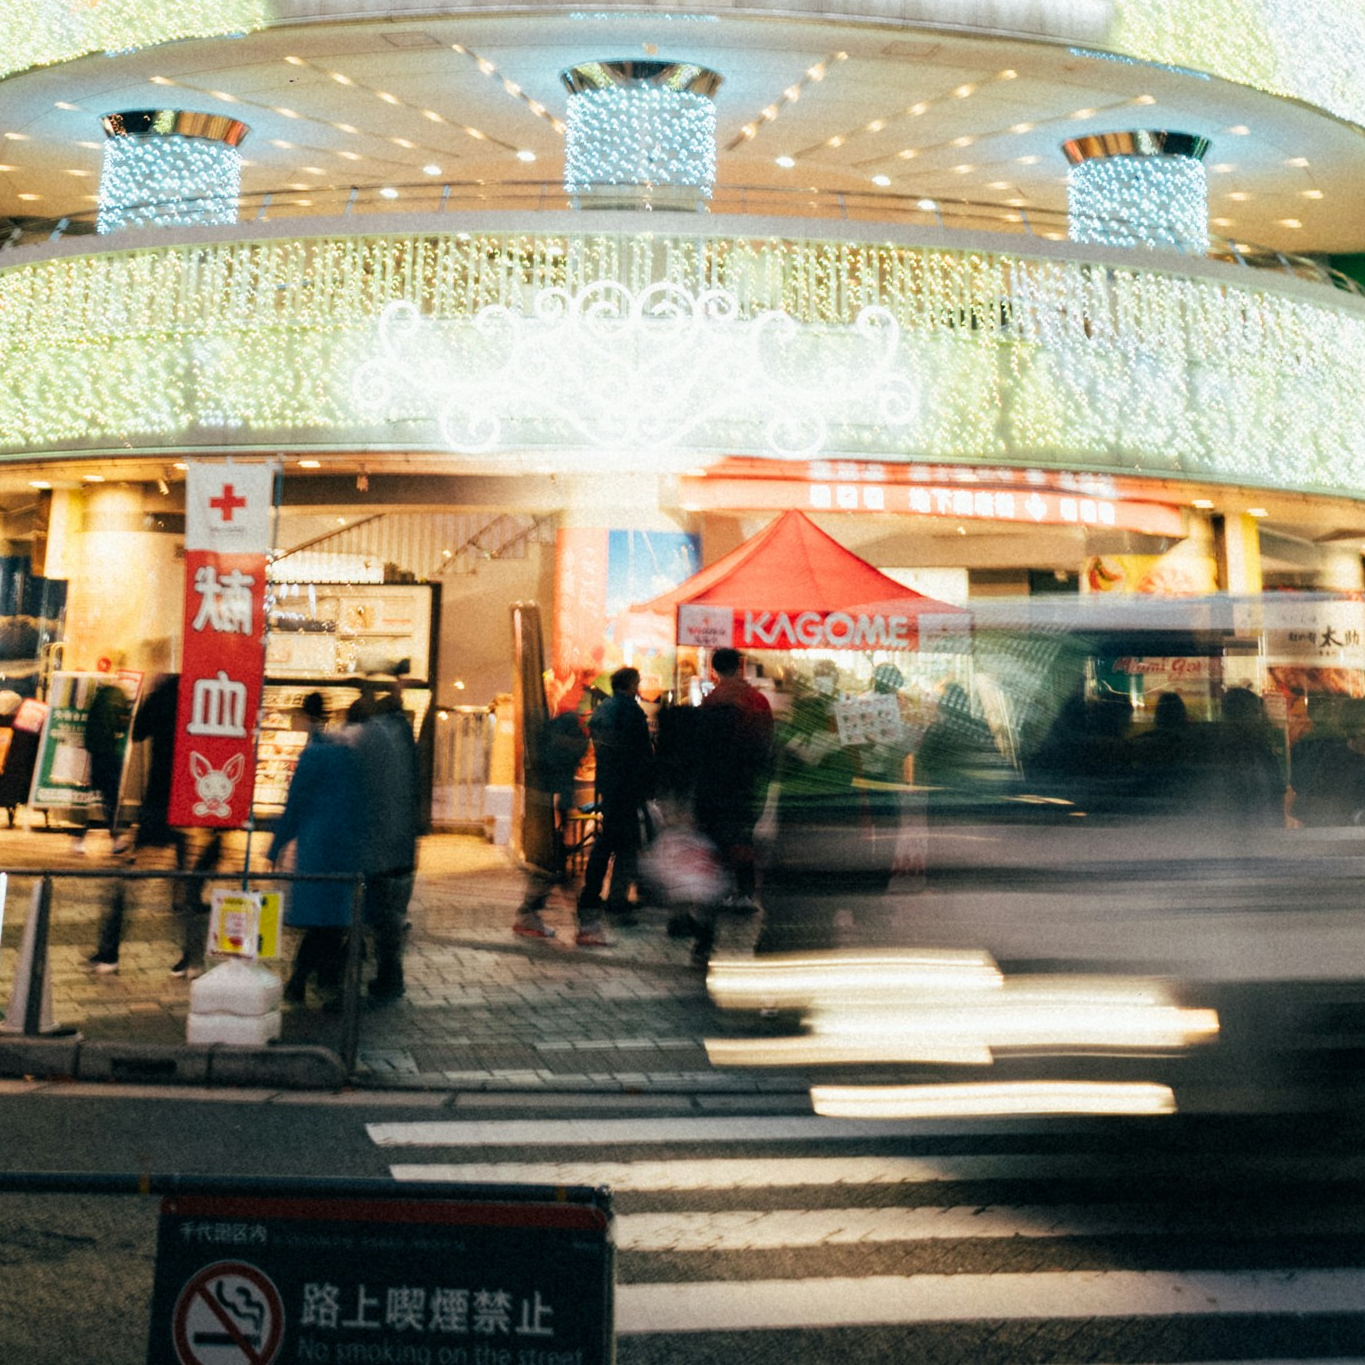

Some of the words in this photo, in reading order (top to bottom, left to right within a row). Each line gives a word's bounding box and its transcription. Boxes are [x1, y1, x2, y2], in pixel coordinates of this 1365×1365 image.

[744, 610, 909, 647] KAGOME
[300, 1282, 555, 1336] 路上喫煙禁止
[297, 1338, 329, 1362] No
[336, 1339, 432, 1365] smoking
[439, 1346, 468, 1365] on
[474, 1344, 512, 1365] the
